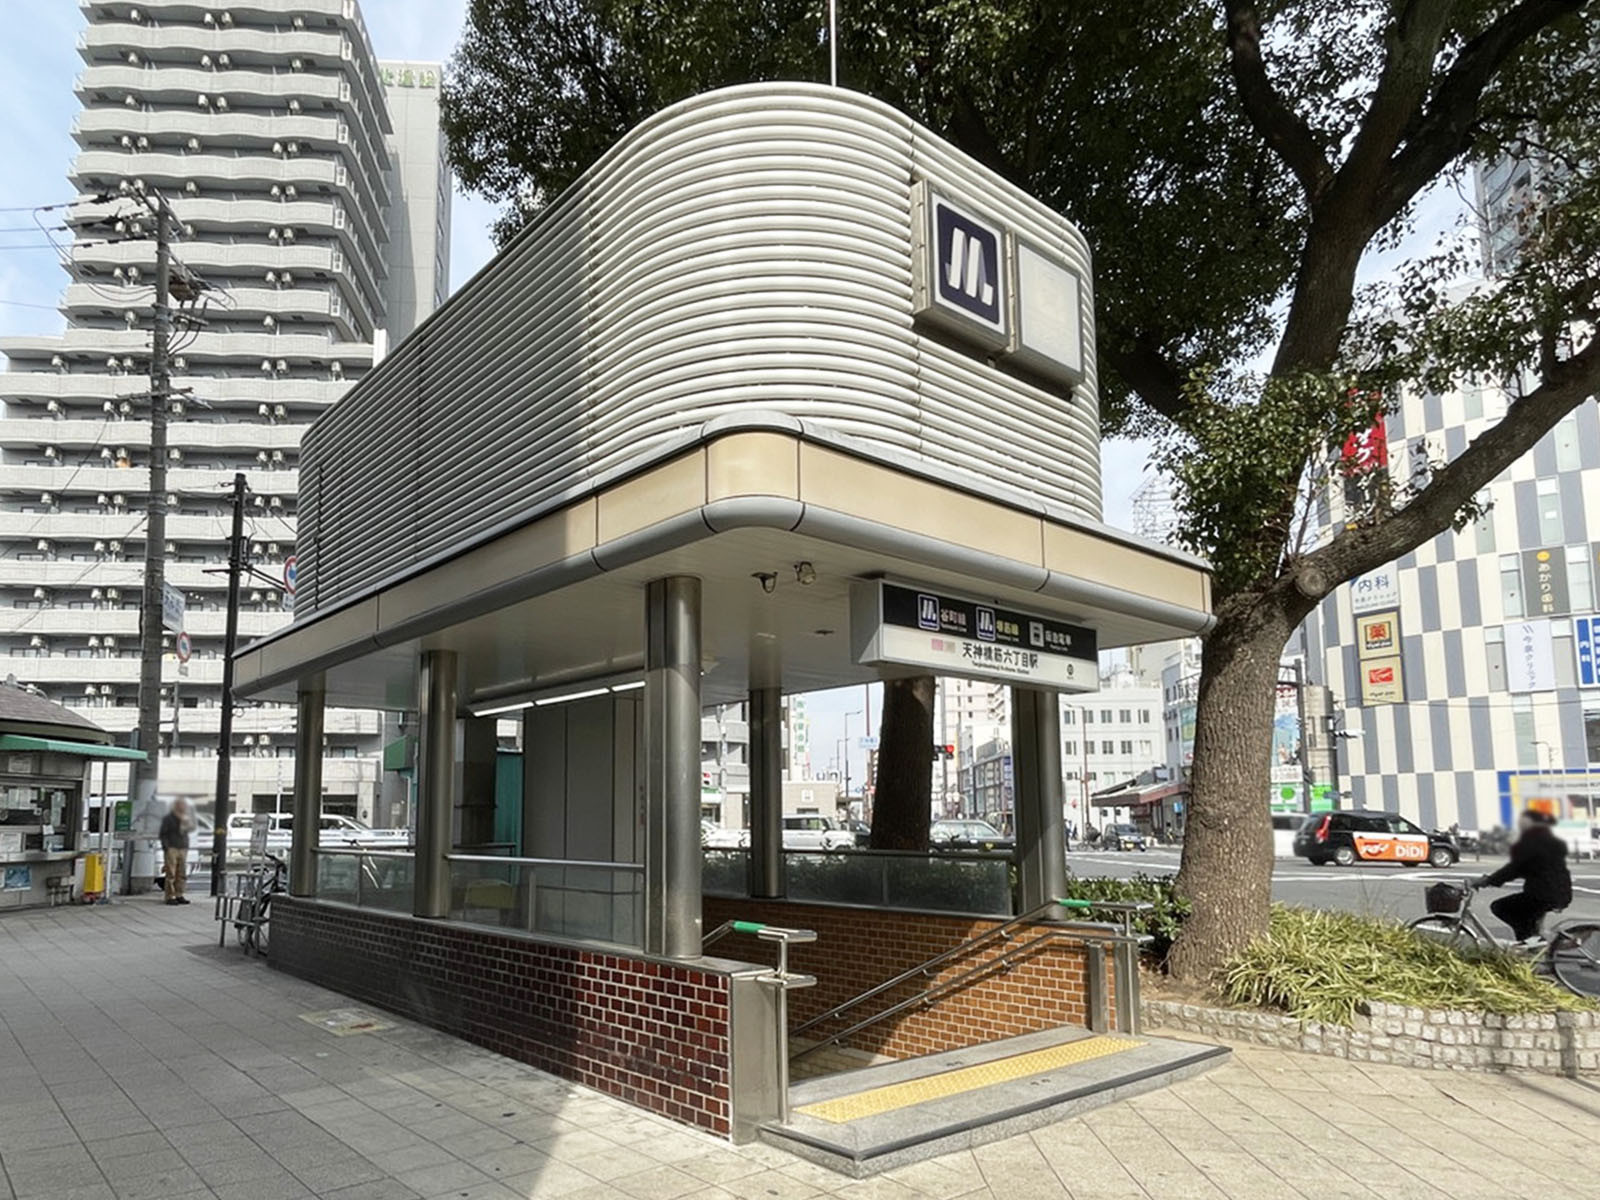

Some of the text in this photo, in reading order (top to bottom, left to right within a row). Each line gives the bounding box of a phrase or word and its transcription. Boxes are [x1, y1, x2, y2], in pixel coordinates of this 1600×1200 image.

[1358, 574, 1389, 593] 内科
[962, 642, 1038, 669] 天神橋筋六丁目駅
[1395, 845, 1424, 857] DiDi
